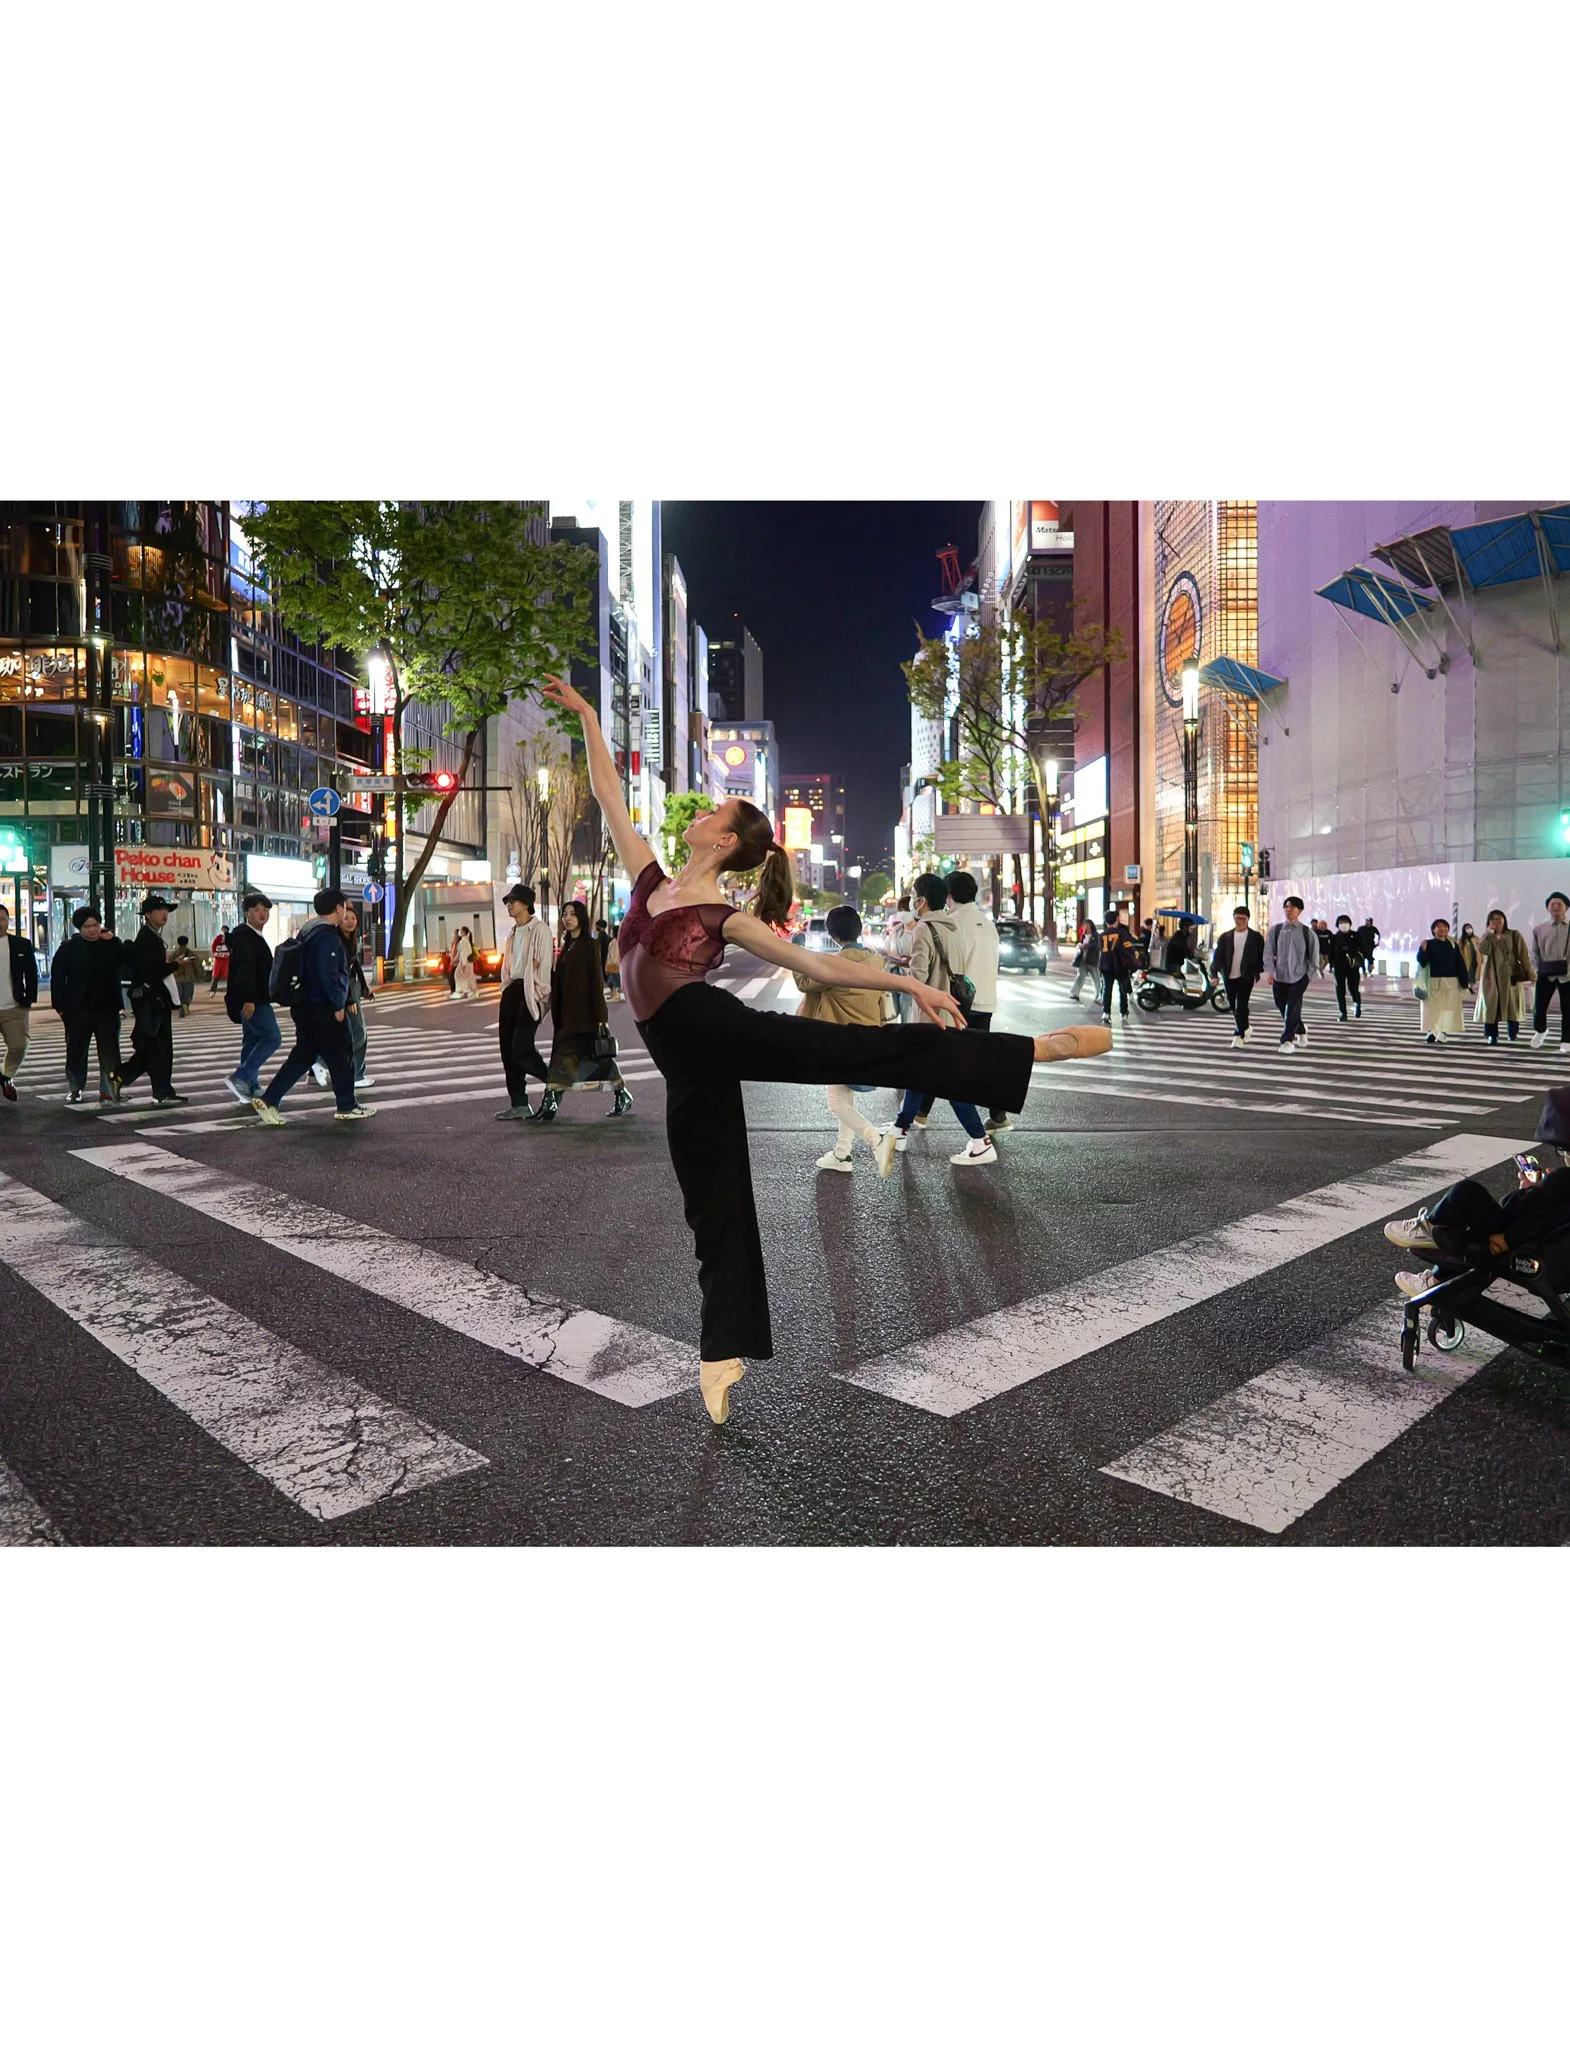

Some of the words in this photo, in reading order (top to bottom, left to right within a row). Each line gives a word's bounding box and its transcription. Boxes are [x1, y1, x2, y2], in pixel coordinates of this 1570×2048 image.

[115, 850, 160, 867] Peko
[163, 852, 201, 869] chan
[121, 867, 176, 883] House
[1102, 933, 1119, 952] 17
